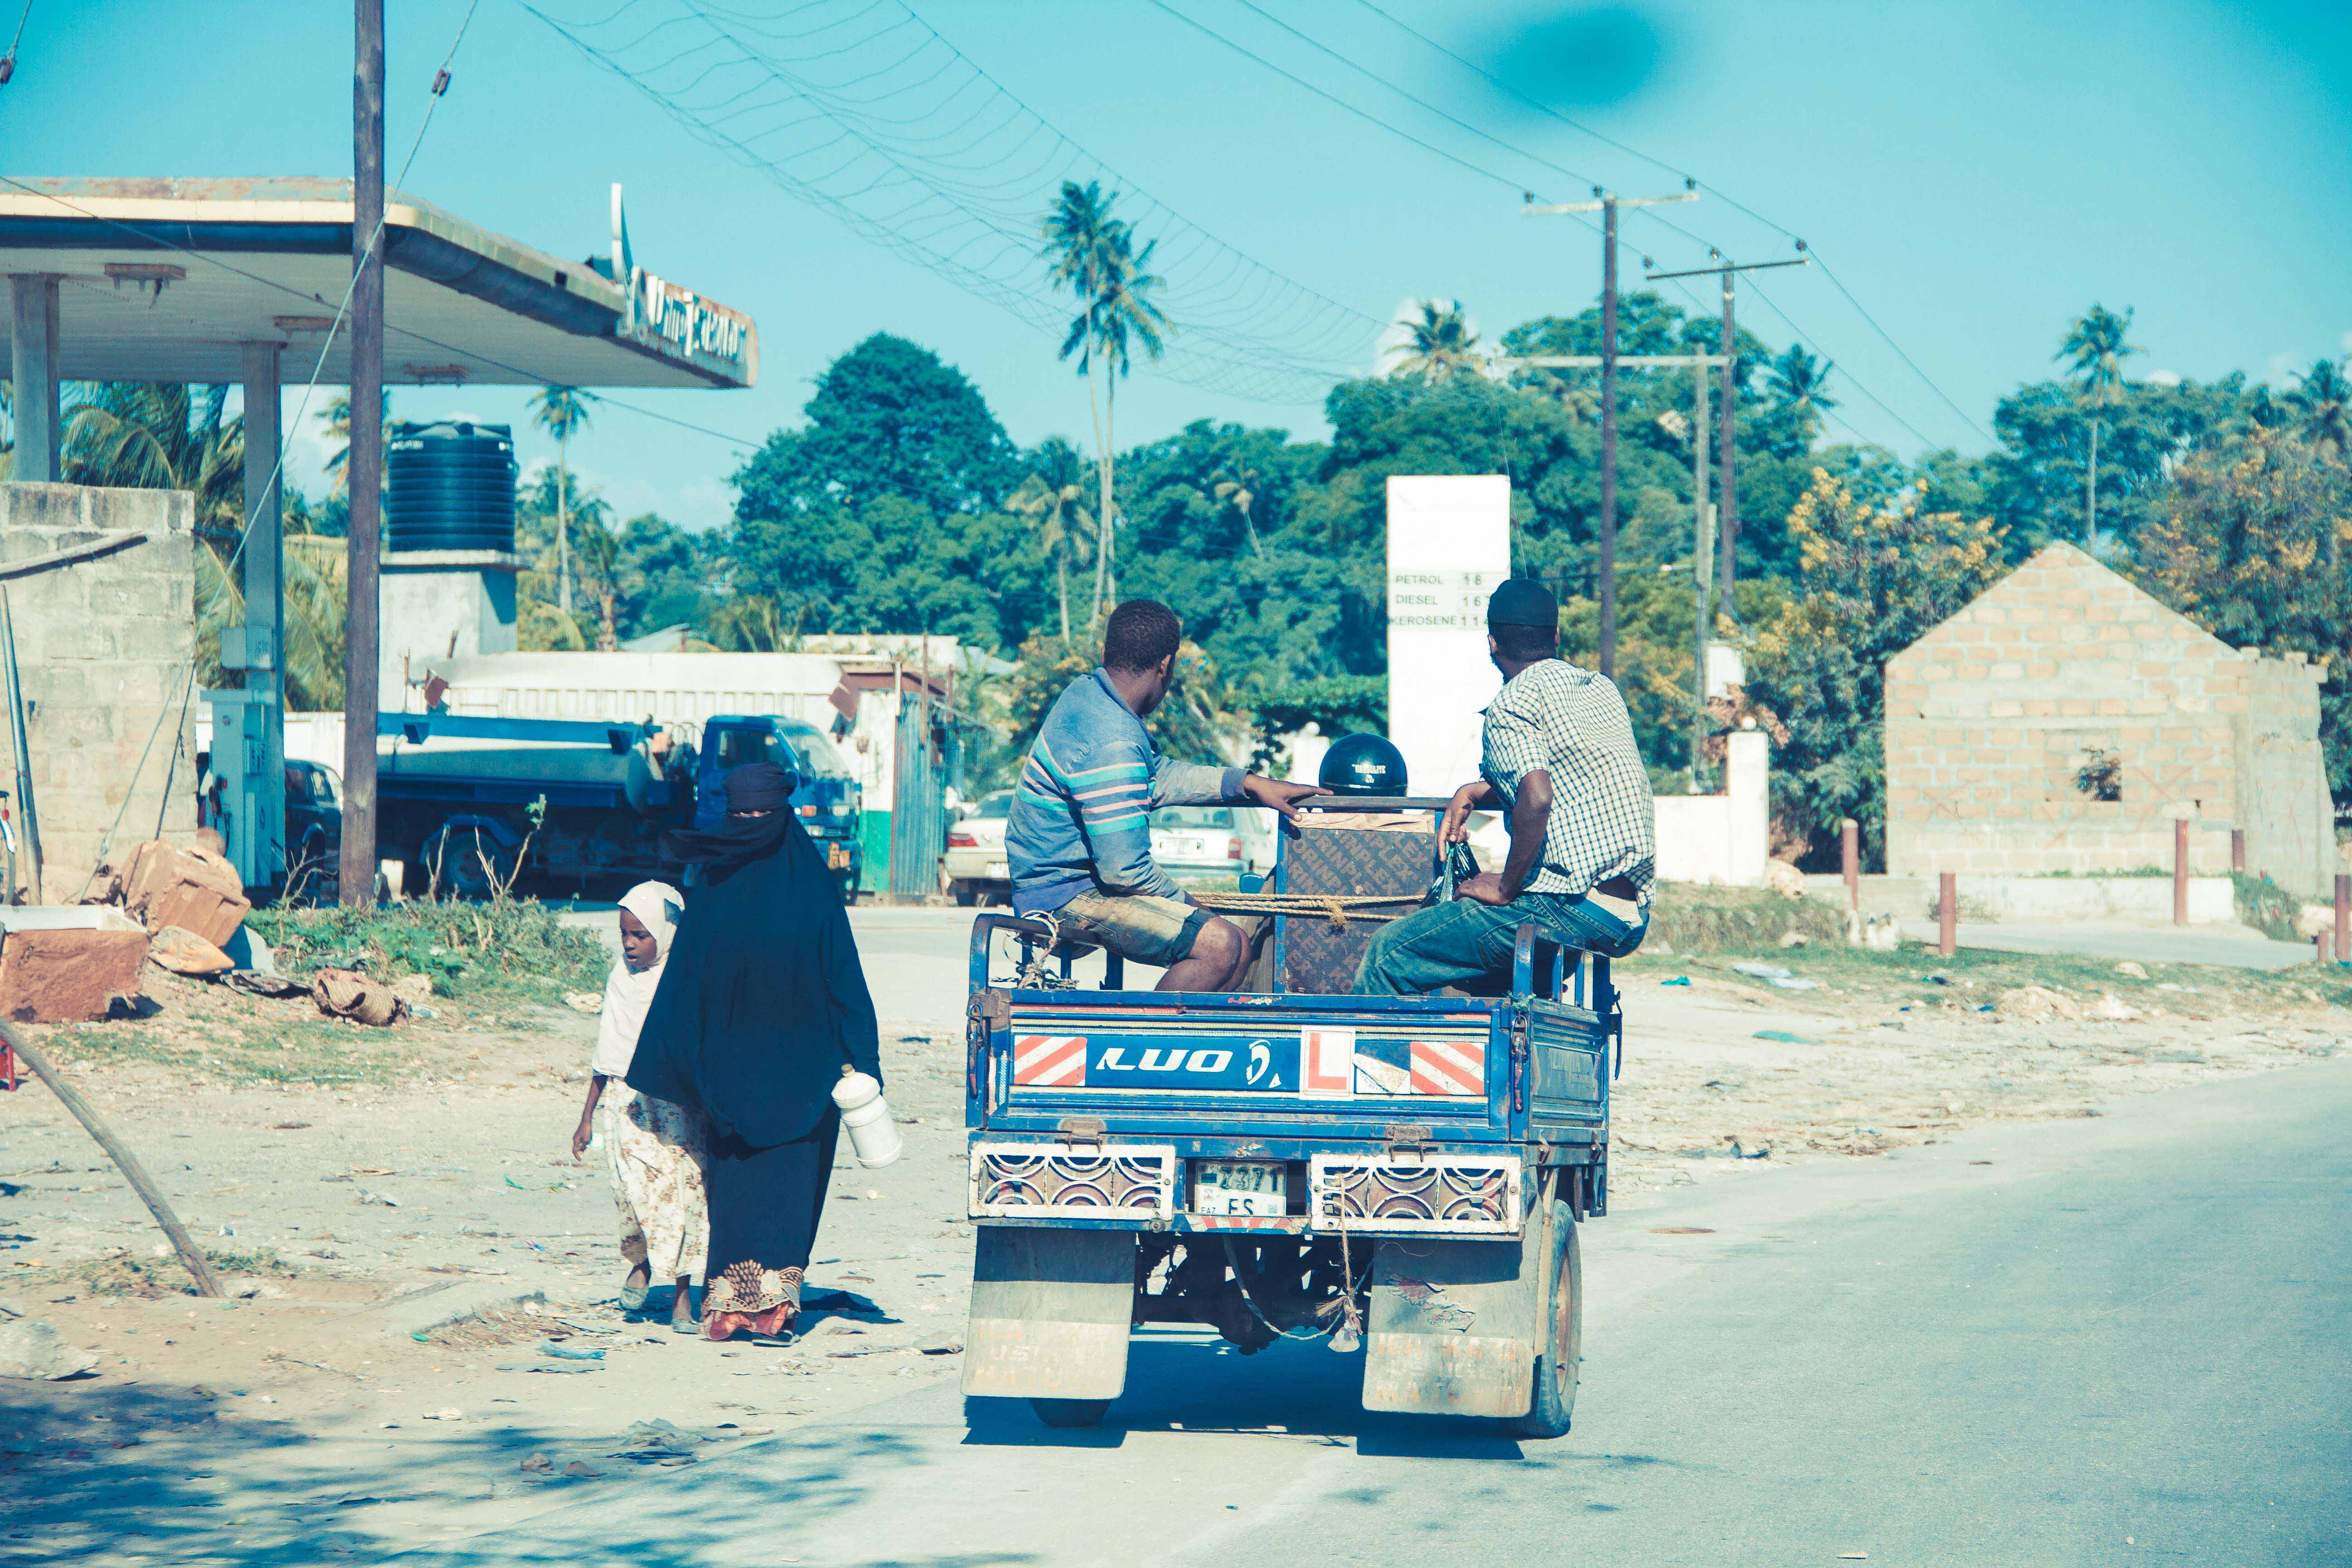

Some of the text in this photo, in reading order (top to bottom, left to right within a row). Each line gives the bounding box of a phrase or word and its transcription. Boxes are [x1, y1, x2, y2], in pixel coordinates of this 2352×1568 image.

[1395, 575, 1443, 584] PETROL
[1396, 595, 1438, 604] DIESEL
[1389, 616, 1457, 626] KEROSENE
[1308, 1033, 1347, 1090] L
